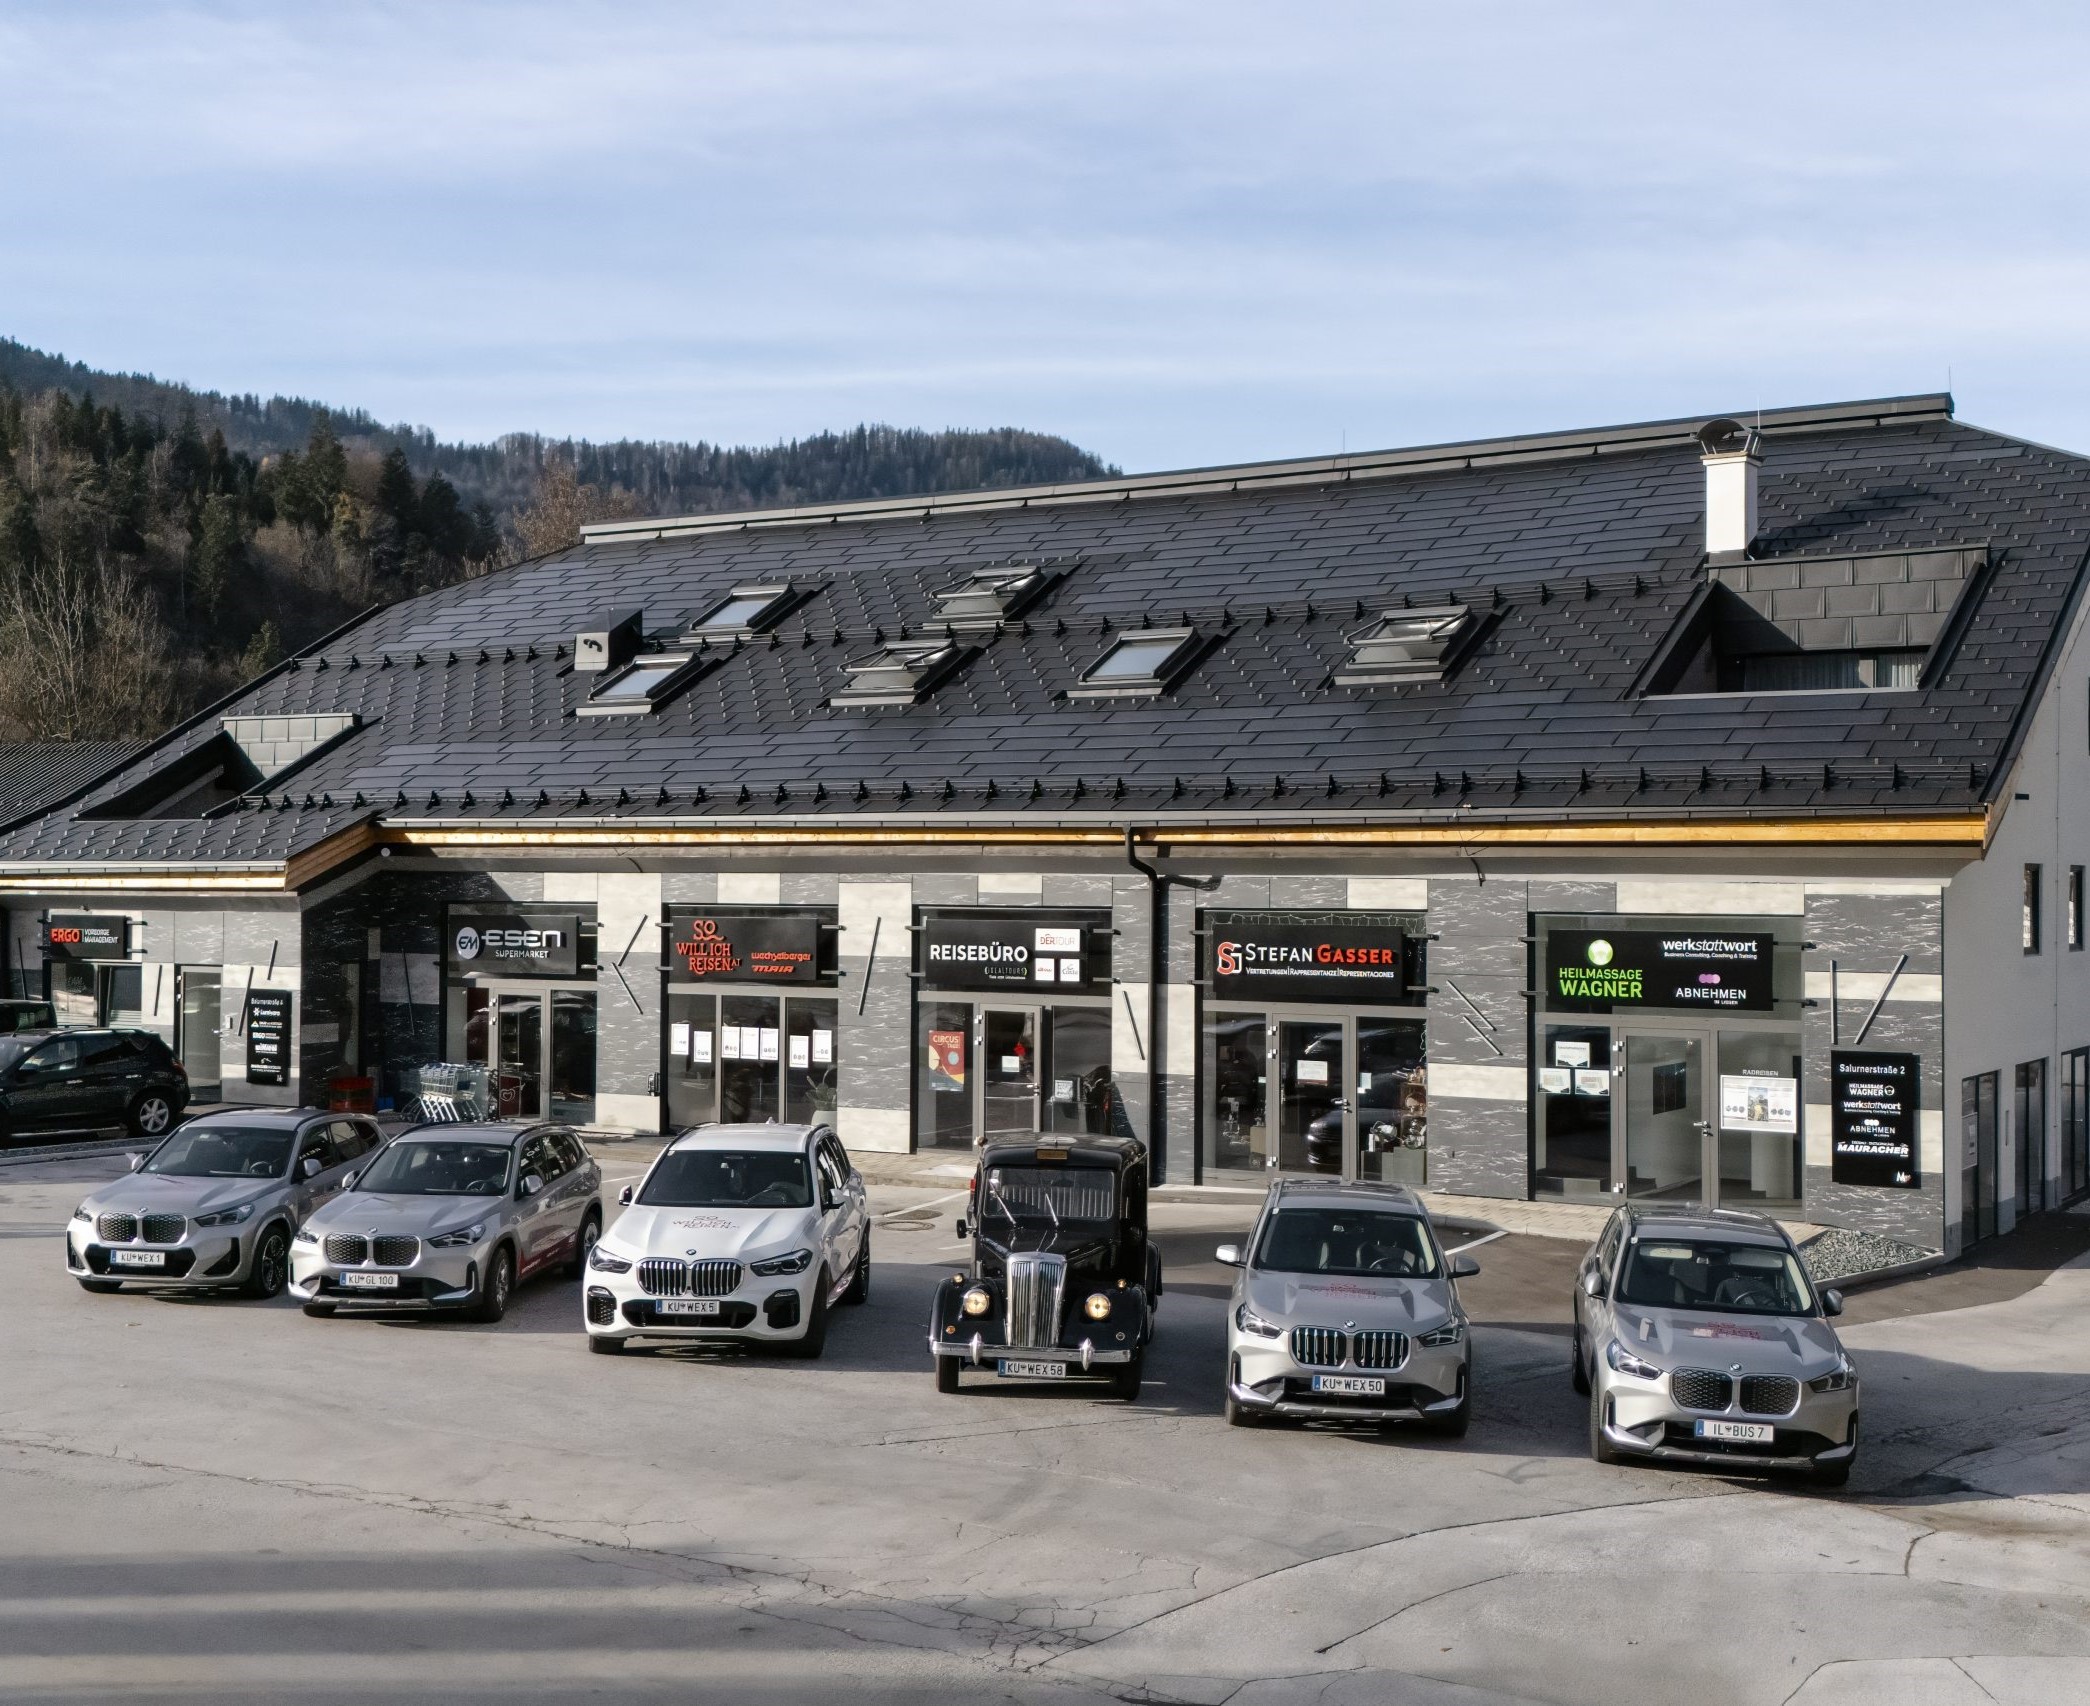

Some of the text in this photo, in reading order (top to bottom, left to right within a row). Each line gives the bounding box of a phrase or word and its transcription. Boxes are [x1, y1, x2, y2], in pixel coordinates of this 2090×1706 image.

[51, 928, 80, 943] ERGO
[692, 920, 724, 940] SO
[84, 936, 119, 944] MANAGEMENT
[459, 936, 478, 950] EM
[1662, 938, 1758, 952] werkstattwort
[495, 949, 549, 959] SUPERMARKET
[676, 942, 732, 957] WILL ICH
[930, 941, 1029, 962] REISEBÜRO
[1245, 942, 1393, 964] STEFAN GASSER
[1559, 967, 1643, 980] HEILMASSAGE
[1559, 979, 1643, 998] WAGNER
[1675, 987, 1747, 1000] ABNEHMEN
[932, 1034, 959, 1043] CIRCUS
[1839, 1063, 1905, 1075] Salurnerstraße 2
[1849, 1088, 1884, 1096] WAGNER
[1843, 1100, 1902, 1110] werkstattwort
[1849, 1125, 1896, 1134] ABNEHMEN
[1837, 1144, 1909, 1155] MAURACHER
[121, 1252, 132, 1262] KU
[137, 1253, 154, 1263] WEX
[348, 1274, 394, 1285] KU GL 100
[667, 1302, 715, 1313] KU WEX 5
[1007, 1362, 1063, 1376] KU WEX 58
[1322, 1378, 1382, 1392] KU WEX 50
[1713, 1423, 1764, 1438] IL BUS 7
